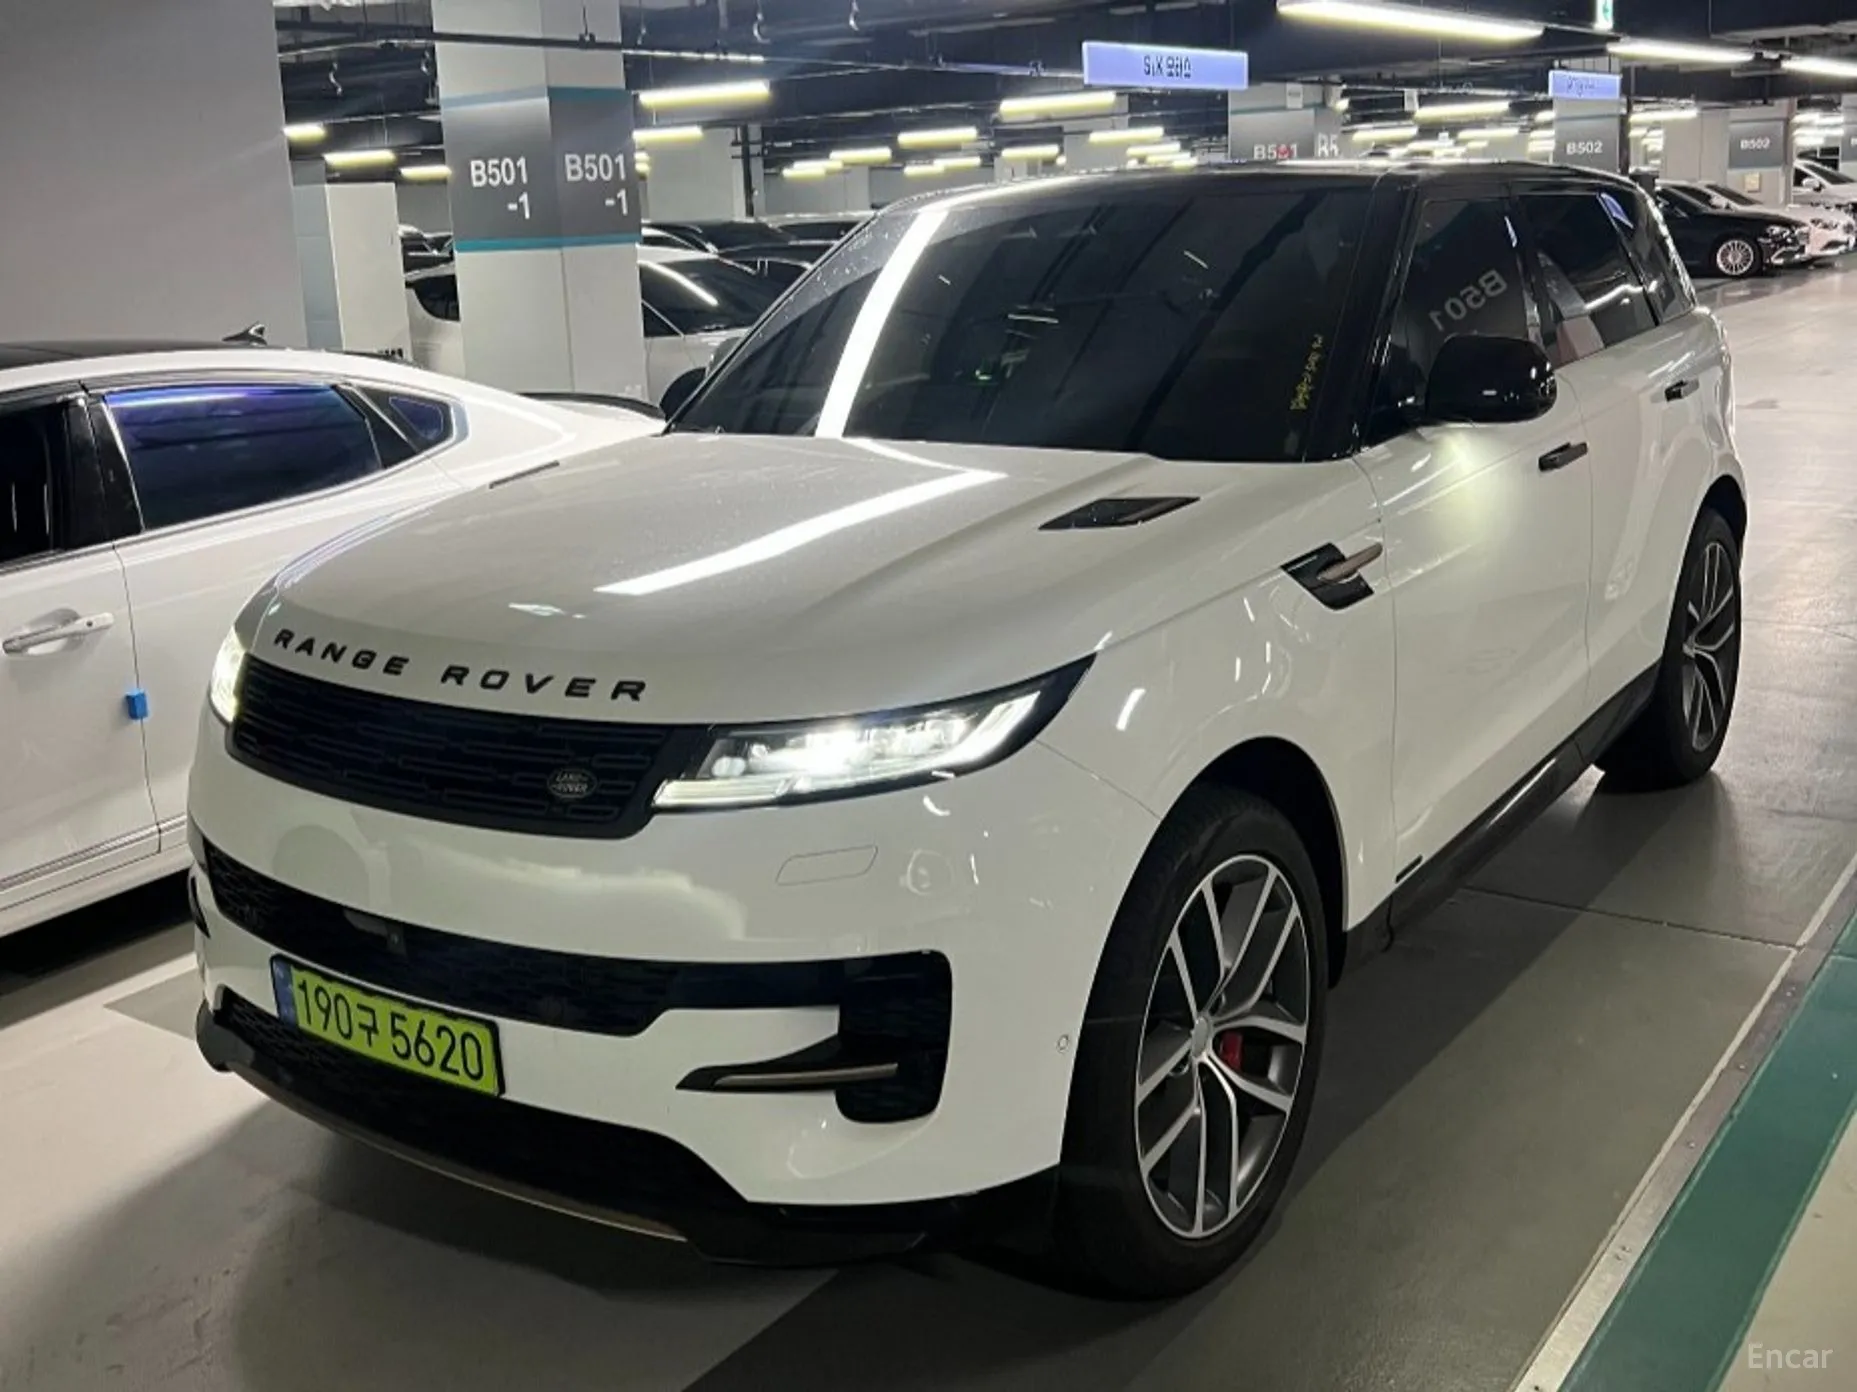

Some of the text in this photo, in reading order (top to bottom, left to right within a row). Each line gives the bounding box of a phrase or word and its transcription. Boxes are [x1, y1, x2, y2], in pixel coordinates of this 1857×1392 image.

[1566, 139, 1604, 156] B502
[470, 156, 528, 187] B501
[564, 153, 627, 182] B501
[507, 191, 531, 220] -1
[604, 188, 629, 216] -1
[273, 628, 647, 702] RANGE ROVER
[298, 979, 484, 1082] 190구 5620
